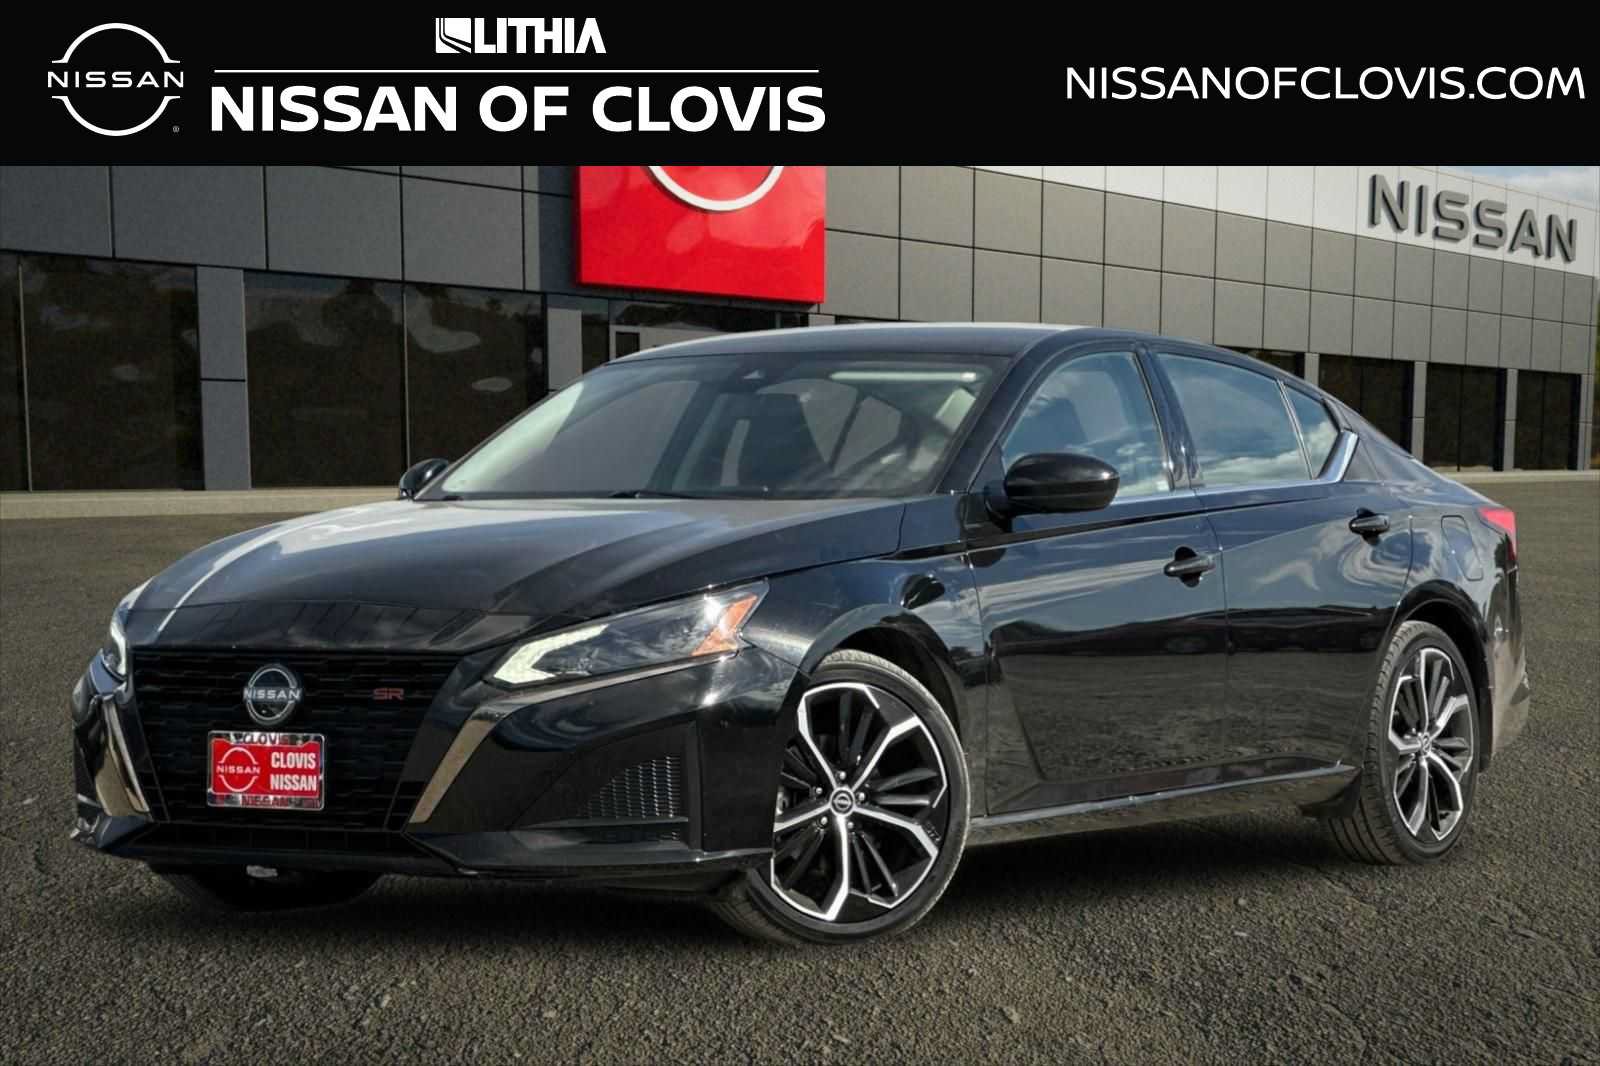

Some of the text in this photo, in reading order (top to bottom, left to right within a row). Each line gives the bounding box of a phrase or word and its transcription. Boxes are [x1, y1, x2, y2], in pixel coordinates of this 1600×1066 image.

[1368, 173, 1577, 263] NISSAN
[243, 687, 301, 700] NISSAN
[373, 687, 404, 701] SR
[271, 752, 316, 769] CLOVIS
[216, 765, 261, 775] NISSAN
[270, 774, 317, 791] NISSAN
